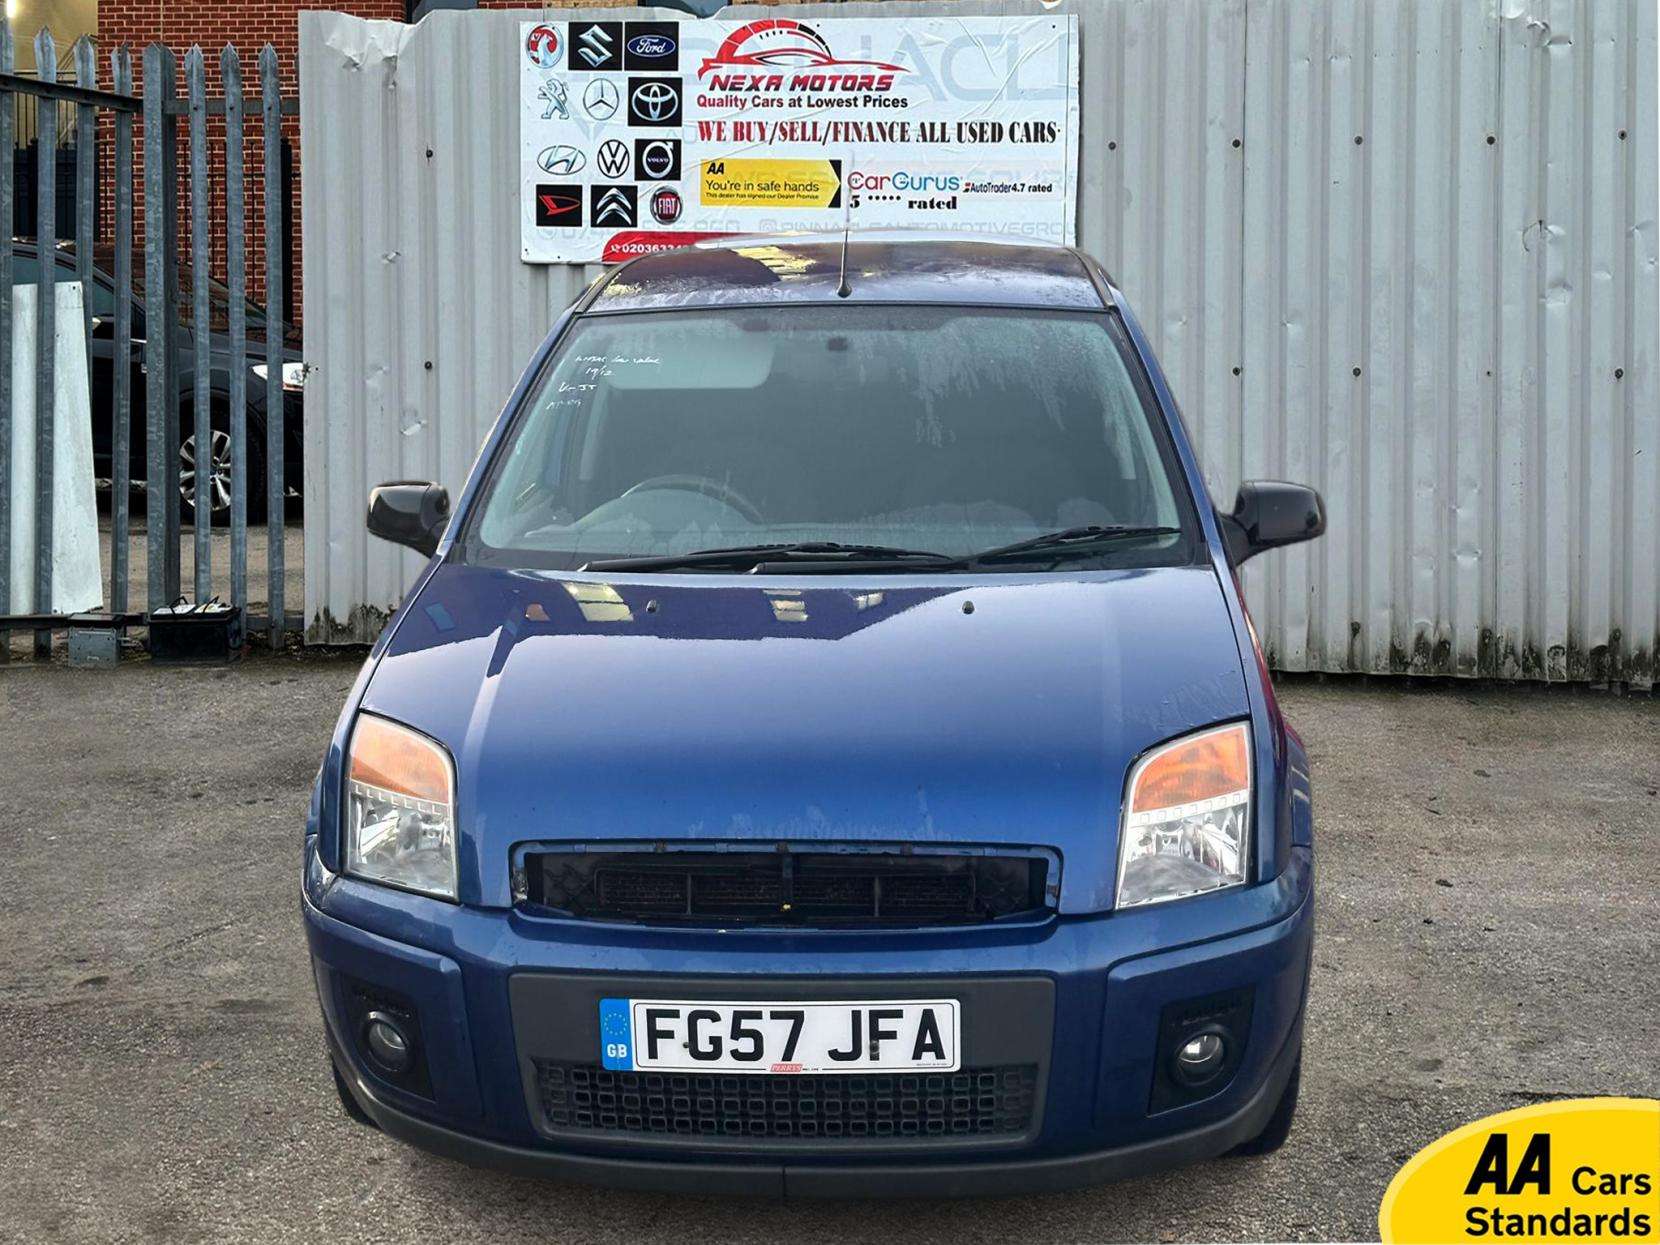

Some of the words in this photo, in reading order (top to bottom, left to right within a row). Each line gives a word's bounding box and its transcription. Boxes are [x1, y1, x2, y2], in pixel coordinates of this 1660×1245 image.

[636, 37, 666, 53] Ford
[709, 75, 785, 92] NEXA
[789, 75, 894, 92] MOTORS
[697, 95, 747, 110] Quality
[752, 95, 784, 108] Cars
[788, 96, 802, 108] at
[807, 95, 859, 108] Lowest
[863, 95, 908, 108] Prices
[697, 121, 727, 142] WE
[916, 121, 950, 143] ALL
[956, 121, 1003, 143] USED
[1009, 121, 1057, 143] CARS
[706, 162, 724, 175] AA
[705, 179, 741, 191] You're
[743, 180, 754, 191] in
[757, 180, 781, 192] safe
[784, 181, 820, 192] hands
[847, 171, 960, 190] CarGurus
[1011, 183, 1026, 193] 4.7
[1028, 183, 1053, 193] rated
[658, 198, 676, 214] FIAT
[849, 195, 860, 209] 5
[908, 196, 957, 210] rated
[606, 1043, 628, 1058] GB
[646, 1008, 805, 1062] FG57
[827, 1008, 946, 1062] JFA
